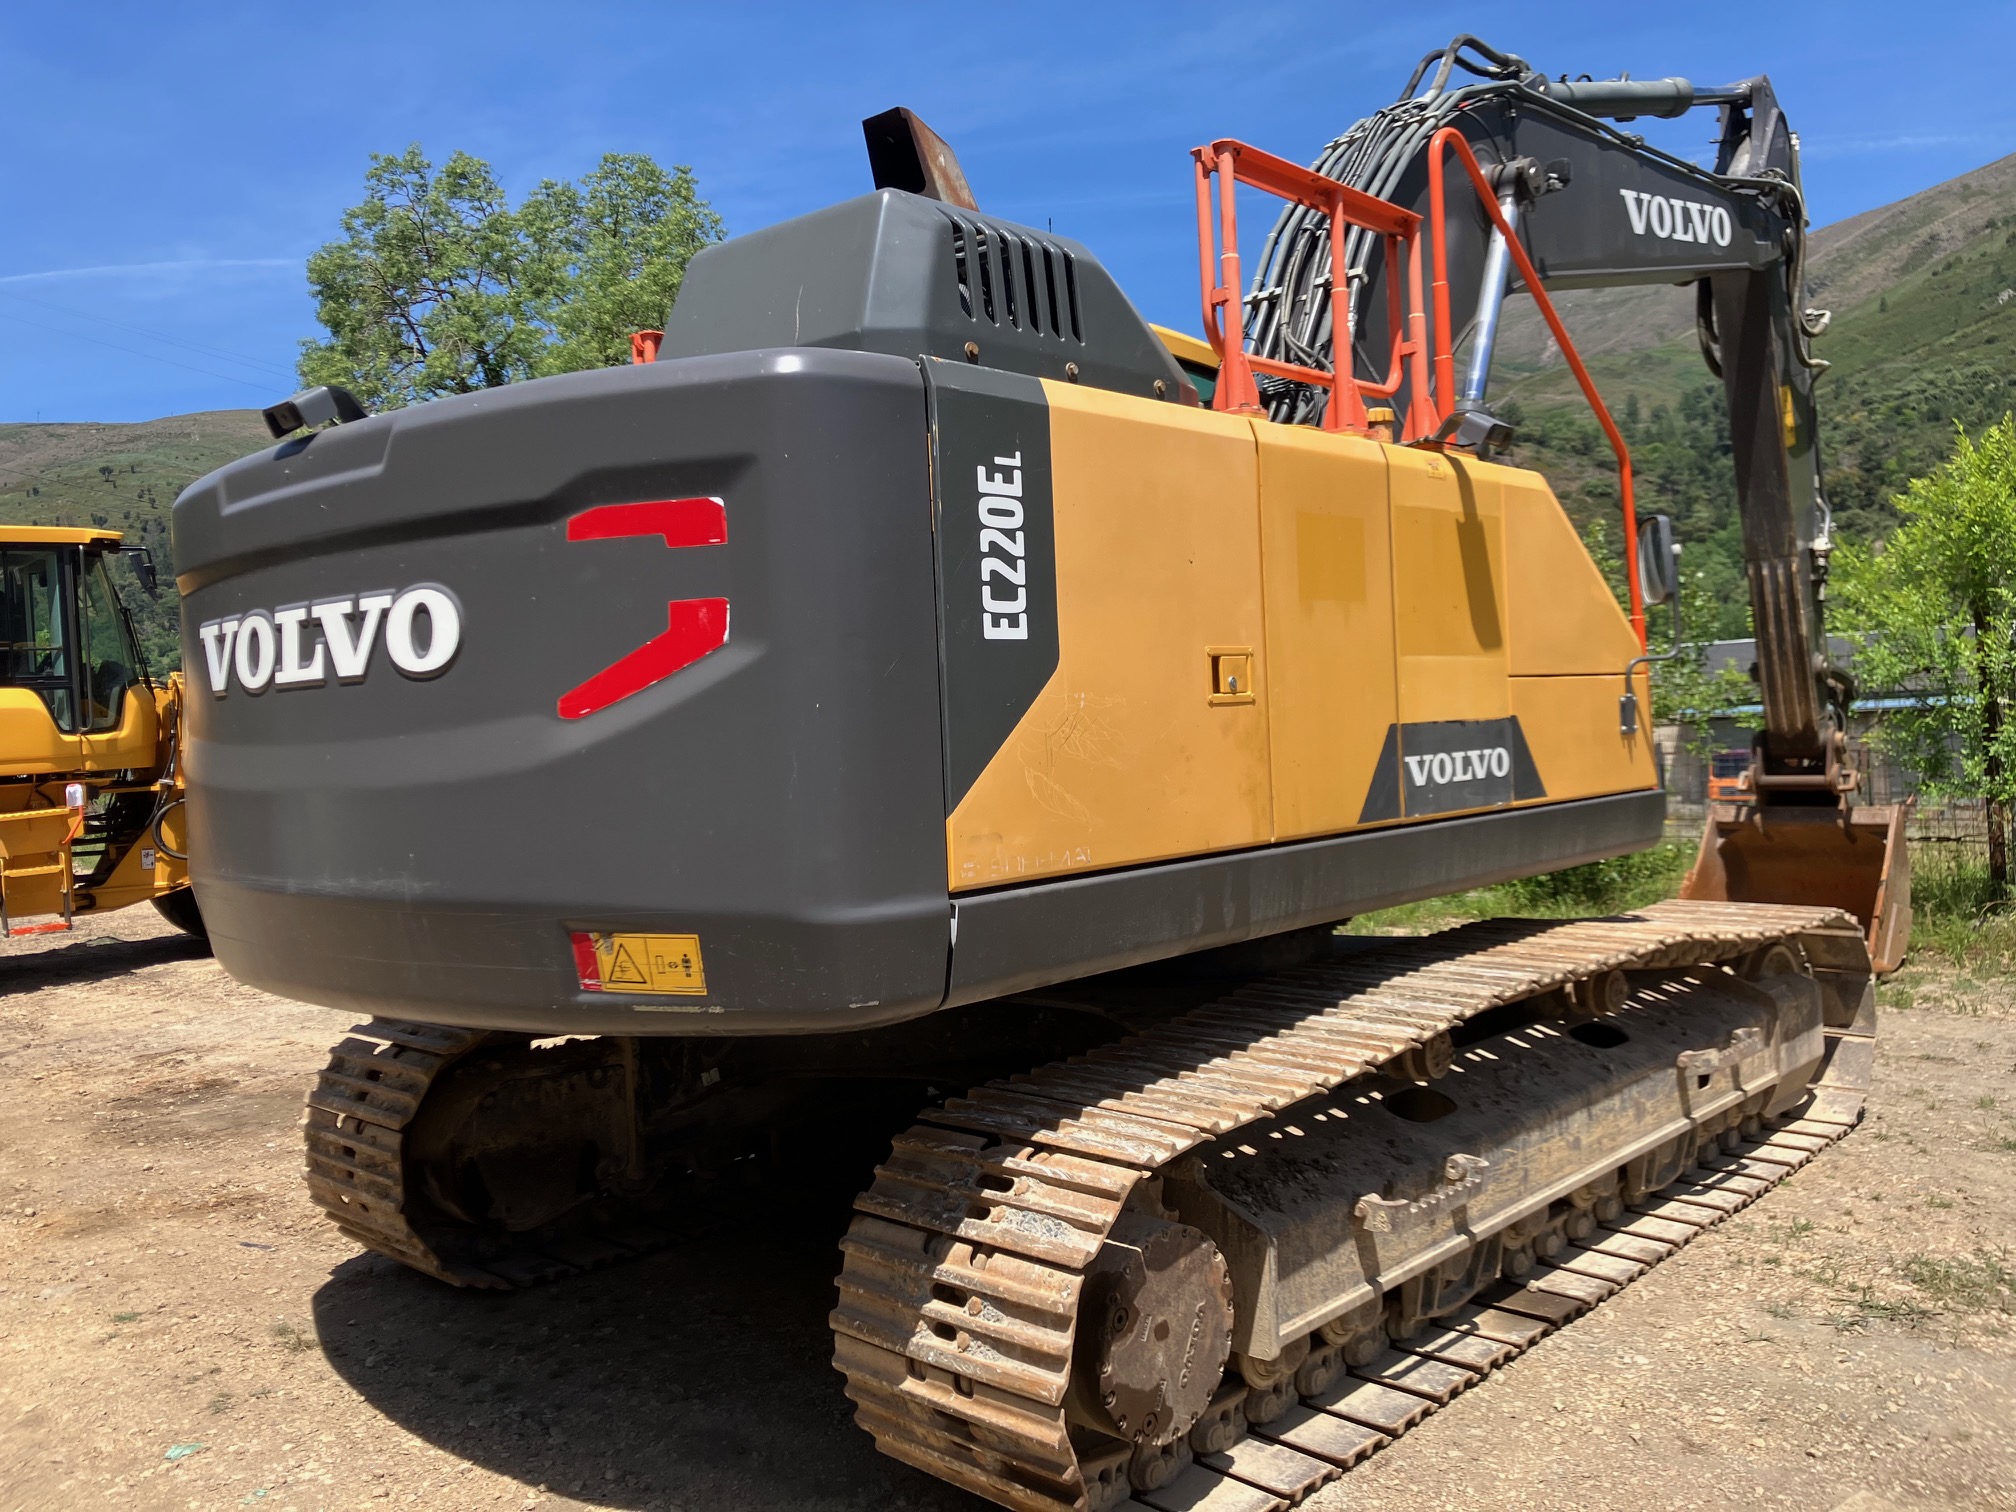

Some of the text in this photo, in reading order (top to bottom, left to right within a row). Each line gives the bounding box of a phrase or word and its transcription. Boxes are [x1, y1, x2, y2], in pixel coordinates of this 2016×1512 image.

[1619, 188, 1732, 247] VOLVO
[199, 584, 461, 697] VOLVO
[1404, 747, 1510, 787] VOLVO
[1179, 1299, 1206, 1389] VOLVO
